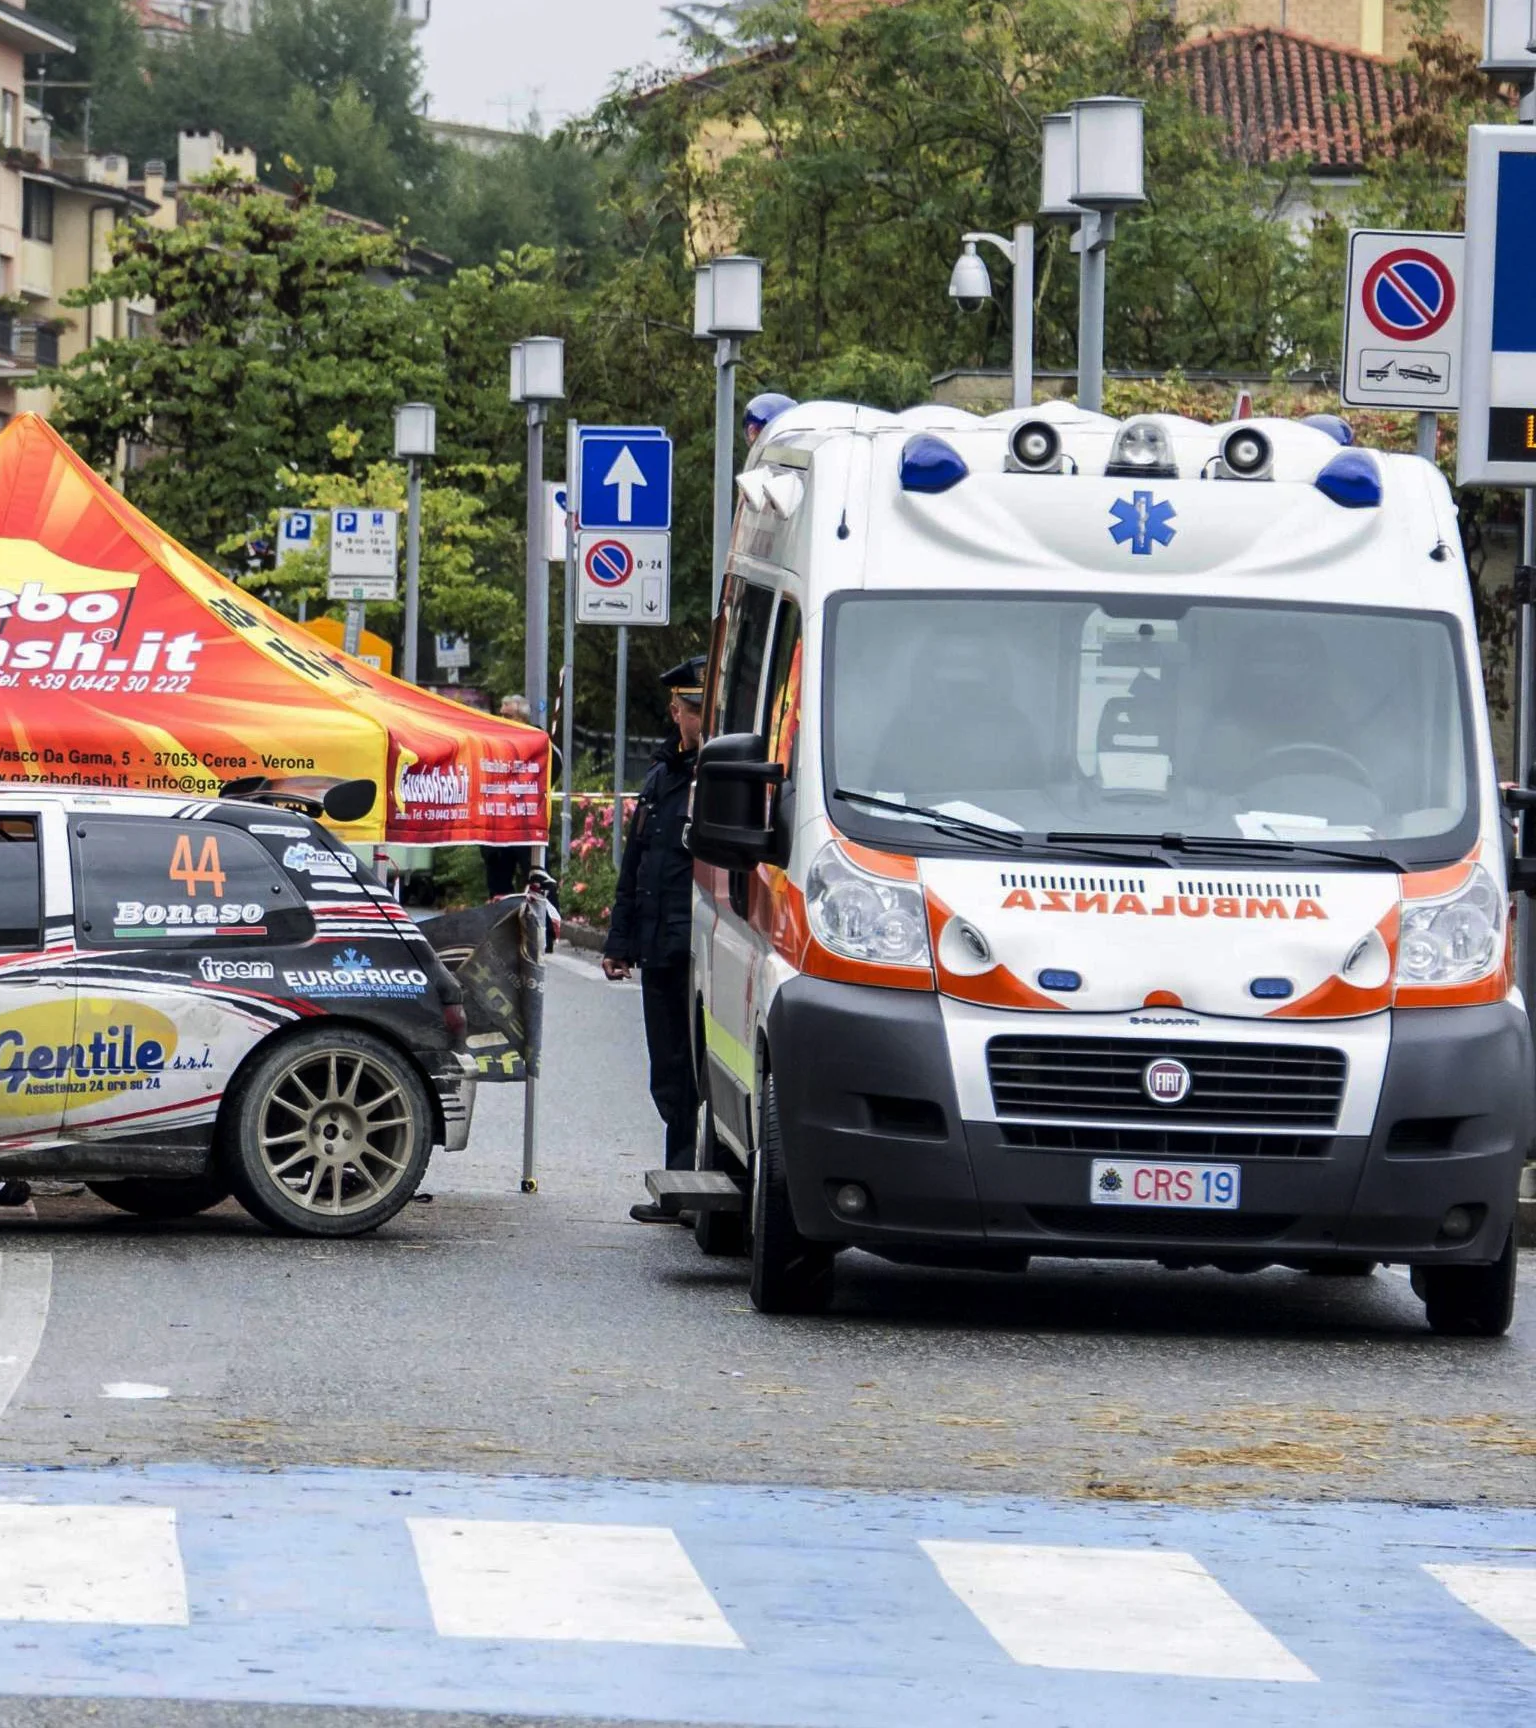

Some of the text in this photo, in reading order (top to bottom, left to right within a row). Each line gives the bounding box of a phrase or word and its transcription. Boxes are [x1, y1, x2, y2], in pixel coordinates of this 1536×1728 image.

[651, 560, 662, 569] 24
[28, 672, 67, 690] +39
[69, 674, 121, 692] 0442
[122, 675, 151, 693] 30
[151, 675, 192, 694] 222
[44, 749, 64, 764] Da
[69, 750, 117, 767] Gama,
[121, 752, 131, 766] 5
[154, 753, 198, 767] 37053
[203, 754, 247, 768] Cerea
[262, 754, 315, 769] Verona
[168, 834, 227, 898] 44
[114, 901, 264, 926] Bonaso
[199, 956, 274, 982] freem
[282, 968, 428, 988] EUROFRIGO
[293, 985, 352, 995] IMPIANTI
[353, 984, 426, 995] FRIGORIFERI
[25, 1077, 161, 1096] Assistenza 24 ore su 24
[1155, 1072, 1181, 1092] FIAT
[1133, 1168, 1234, 1204] CRS 19
